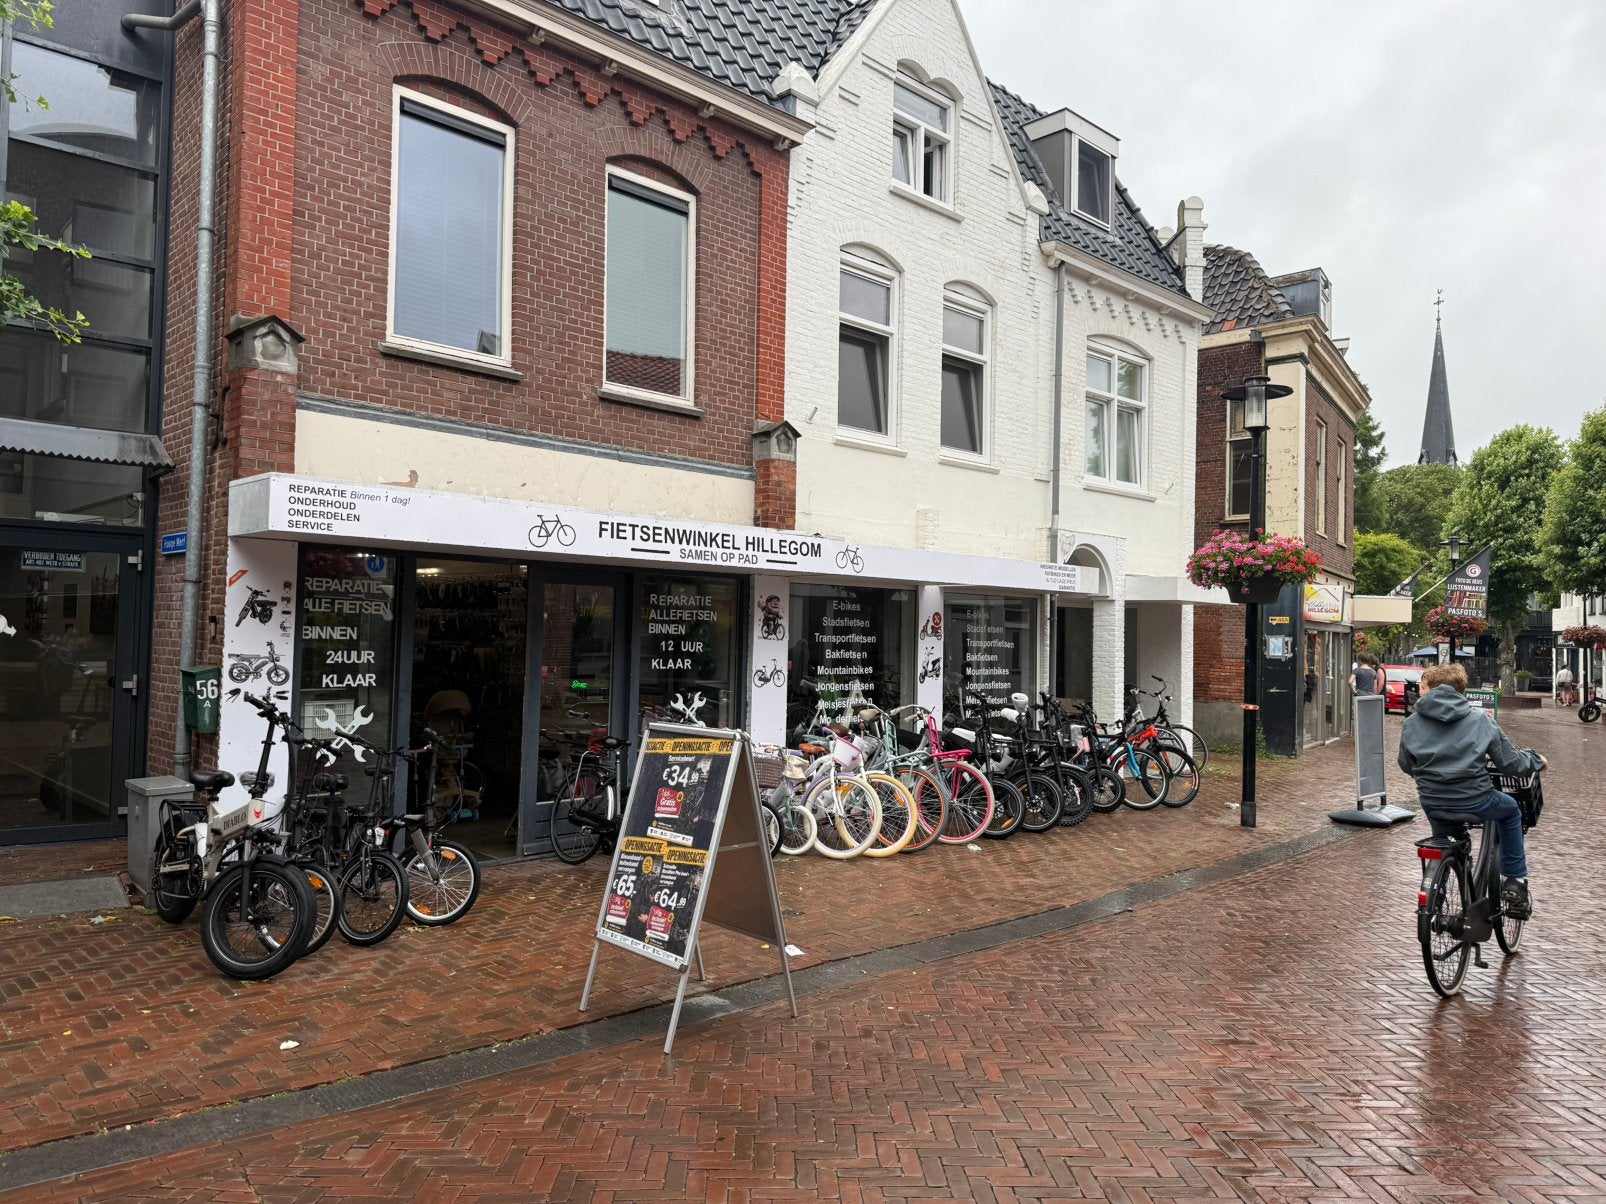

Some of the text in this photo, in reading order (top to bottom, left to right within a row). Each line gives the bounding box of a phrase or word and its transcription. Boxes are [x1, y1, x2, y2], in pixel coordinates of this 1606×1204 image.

[288, 484, 347, 498] REPARATIE
[350, 490, 381, 502] Binnen
[391, 496, 411, 507] dag!
[288, 496, 356, 510] ONDERHOUD
[288, 508, 361, 522] ONDERDELEN
[288, 520, 334, 532] SERVICE
[599, 520, 822, 558] FIETSENWINKEL HILLEGOM
[680, 548, 758, 565] SAMEN OP PAD
[304, 577, 384, 594] REPARATIE
[650, 594, 712, 606] REPARATIE
[832, 600, 860, 611] E-bikes
[304, 598, 390, 615] ALLE FIETSEN
[1448, 608, 1483, 616] PASFOTO'S
[822, 616, 870, 628] Stadsfietsen
[302, 626, 358, 640] BINNEN
[649, 623, 686, 635] BINNEN
[966, 624, 1003, 634] Stadsfetsen
[814, 633, 876, 644] Transportfietsen
[966, 638, 1014, 648] Transportfietsen
[661, 640, 703, 652] 12 UUR
[826, 649, 867, 659] Bakfietsen
[966, 652, 998, 661] Bakfietsen
[651, 658, 692, 670] KLAAR
[817, 666, 873, 675] Mountainbikes
[966, 667, 1009, 675] Mountainbikes
[322, 674, 376, 688] KLAAR
[815, 682, 874, 692] Jongensfietsen
[966, 682, 1011, 691] Jongensfietsen
[196, 679, 218, 700] 56
[1466, 692, 1495, 700] PASFOTO'S
[203, 700, 211, 708] A
[672, 742, 712, 752] OPENINGSACTIE
[224, 811, 247, 830] DIABLO
[625, 840, 664, 852] OPENINGSACTIE
[667, 849, 706, 863] OPENINGSACTIE
